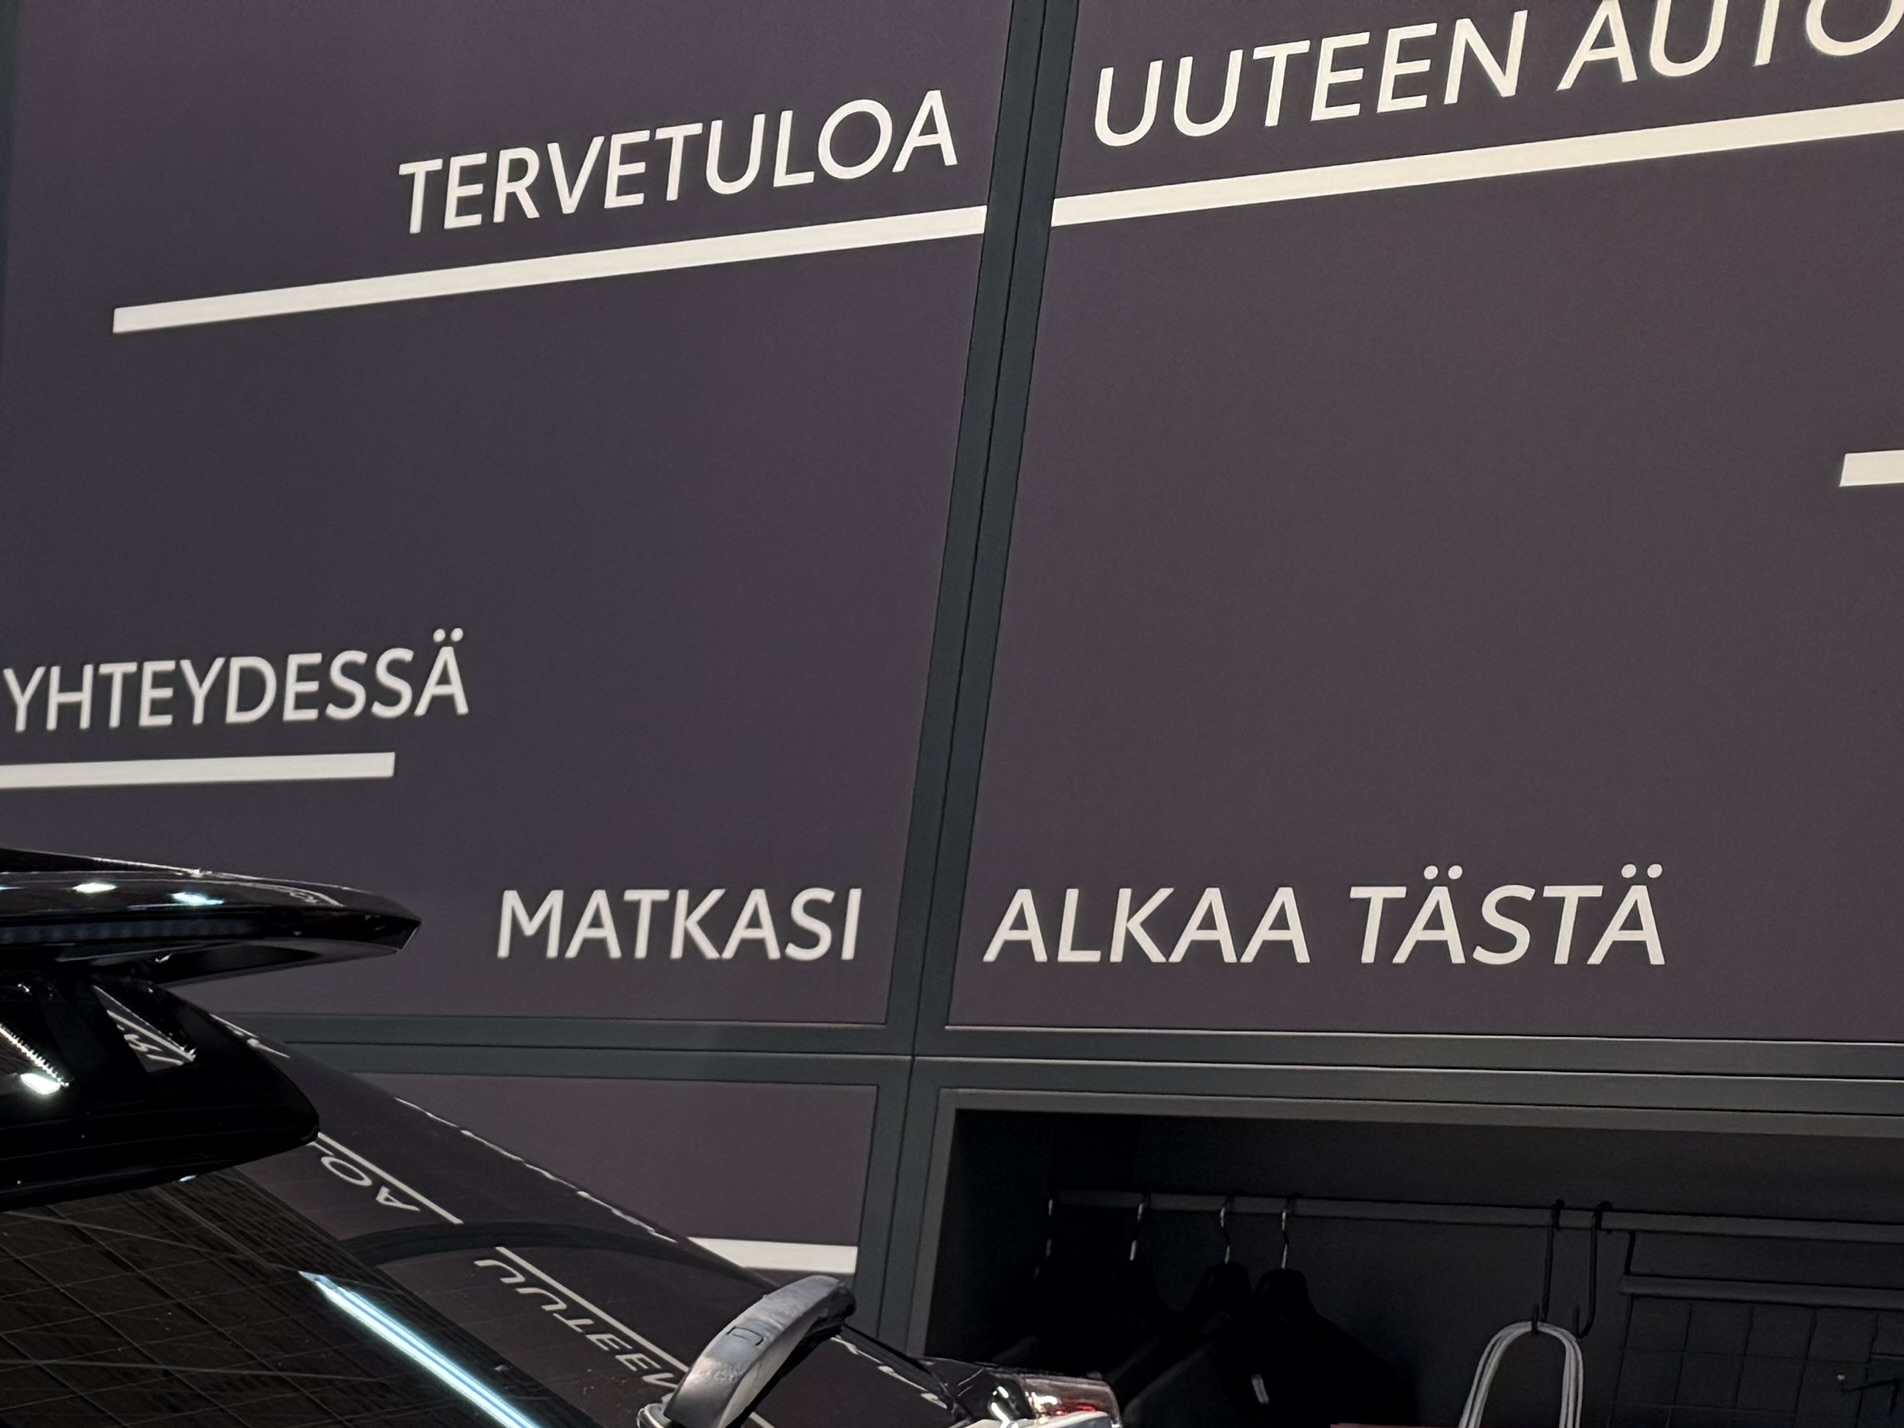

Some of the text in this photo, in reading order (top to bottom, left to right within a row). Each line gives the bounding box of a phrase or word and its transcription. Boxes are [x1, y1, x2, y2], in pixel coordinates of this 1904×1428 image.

[398, 89, 959, 234] TERVETULOA
[1093, 9, 1530, 147] UUTEEN
[2, 627, 470, 732] YHTEYDESSÄ
[497, 863, 1666, 966] MATKASI ALKAA TÄSTÄ
